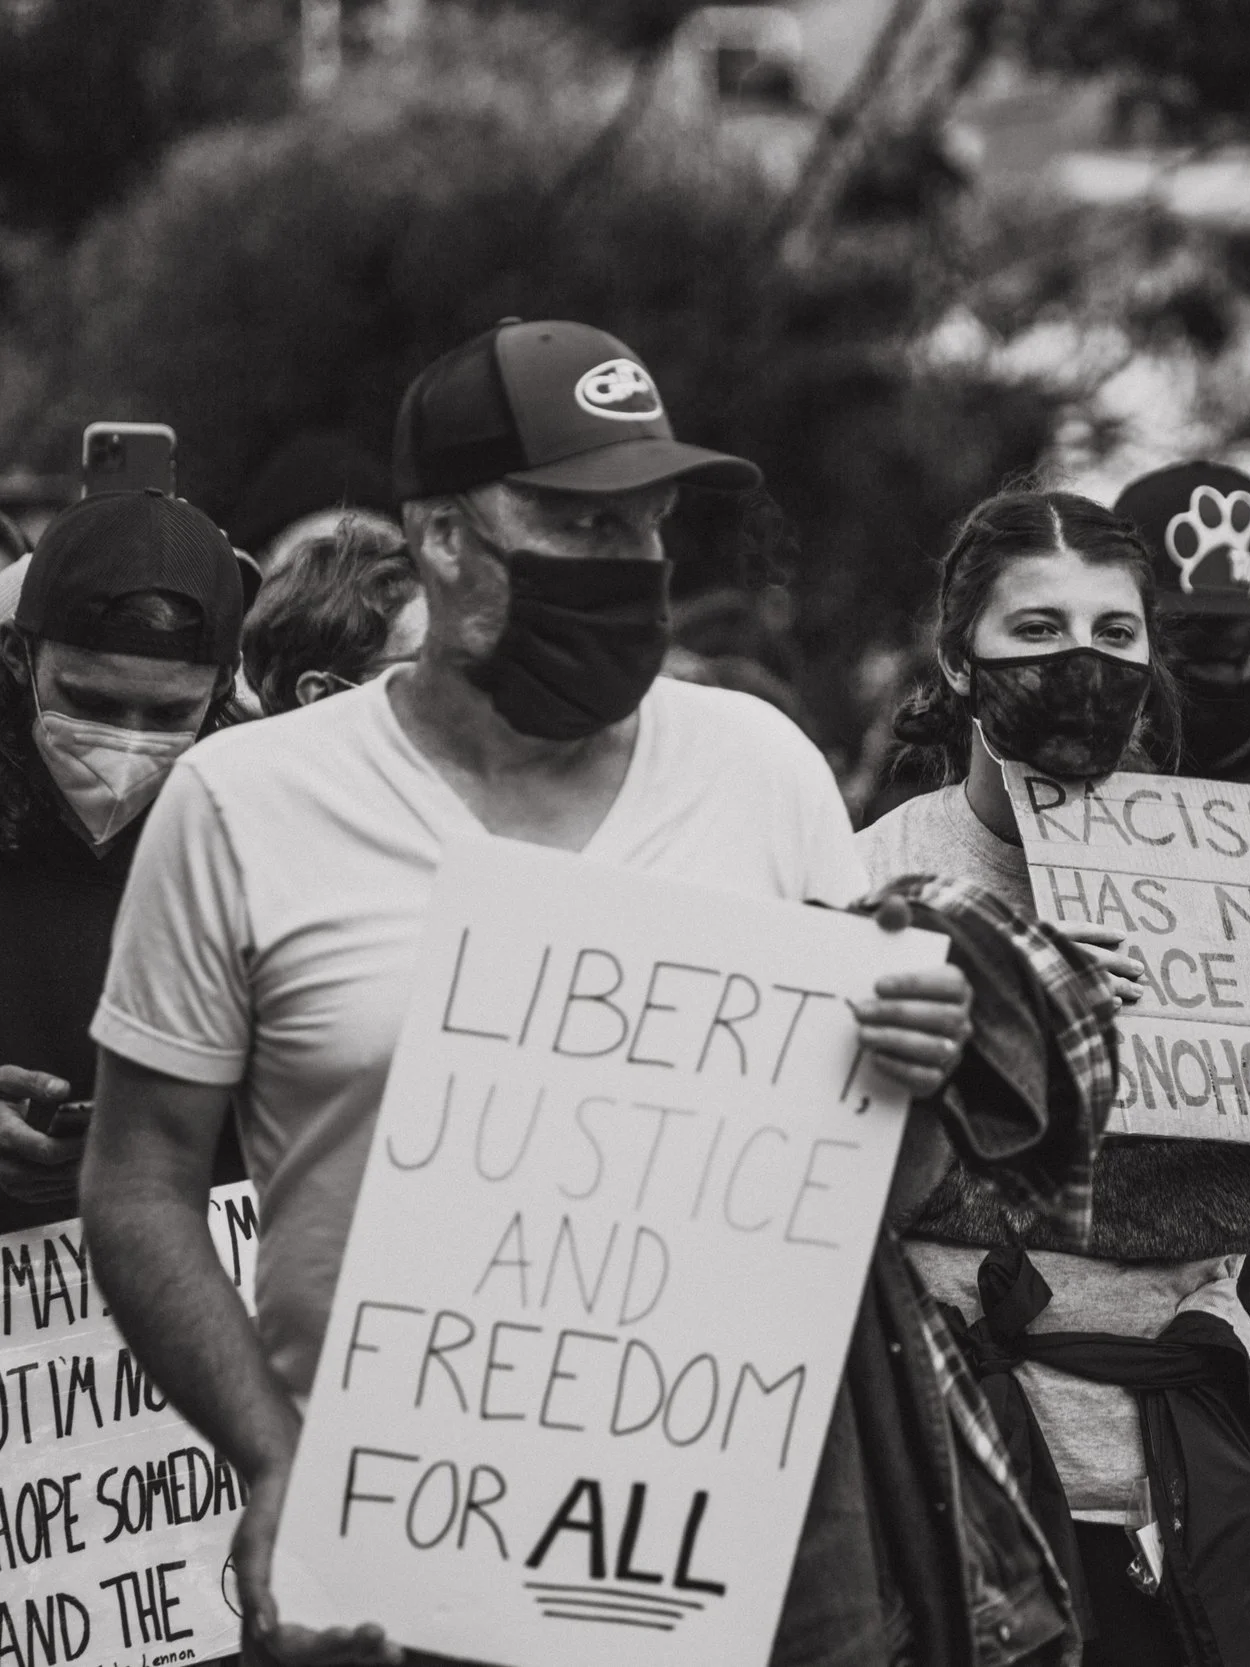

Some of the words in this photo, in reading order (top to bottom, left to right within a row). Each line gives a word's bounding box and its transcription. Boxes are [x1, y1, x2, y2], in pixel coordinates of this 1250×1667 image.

[1046, 868, 1177, 935] HAS
[1127, 945, 1244, 1009] ACE
[386, 1071, 862, 1248] JUSTICE
[2, 1233, 89, 1335] MAY
[209, 1195, 259, 1287] 'M
[473, 1210, 670, 1327] AND
[47, 1355, 104, 1439] I'M
[341, 1300, 807, 1471] FREEDOM
[339, 1446, 509, 1560] FOR
[524, 1477, 727, 1597] ALL
[99, 1559, 194, 1648] THE
